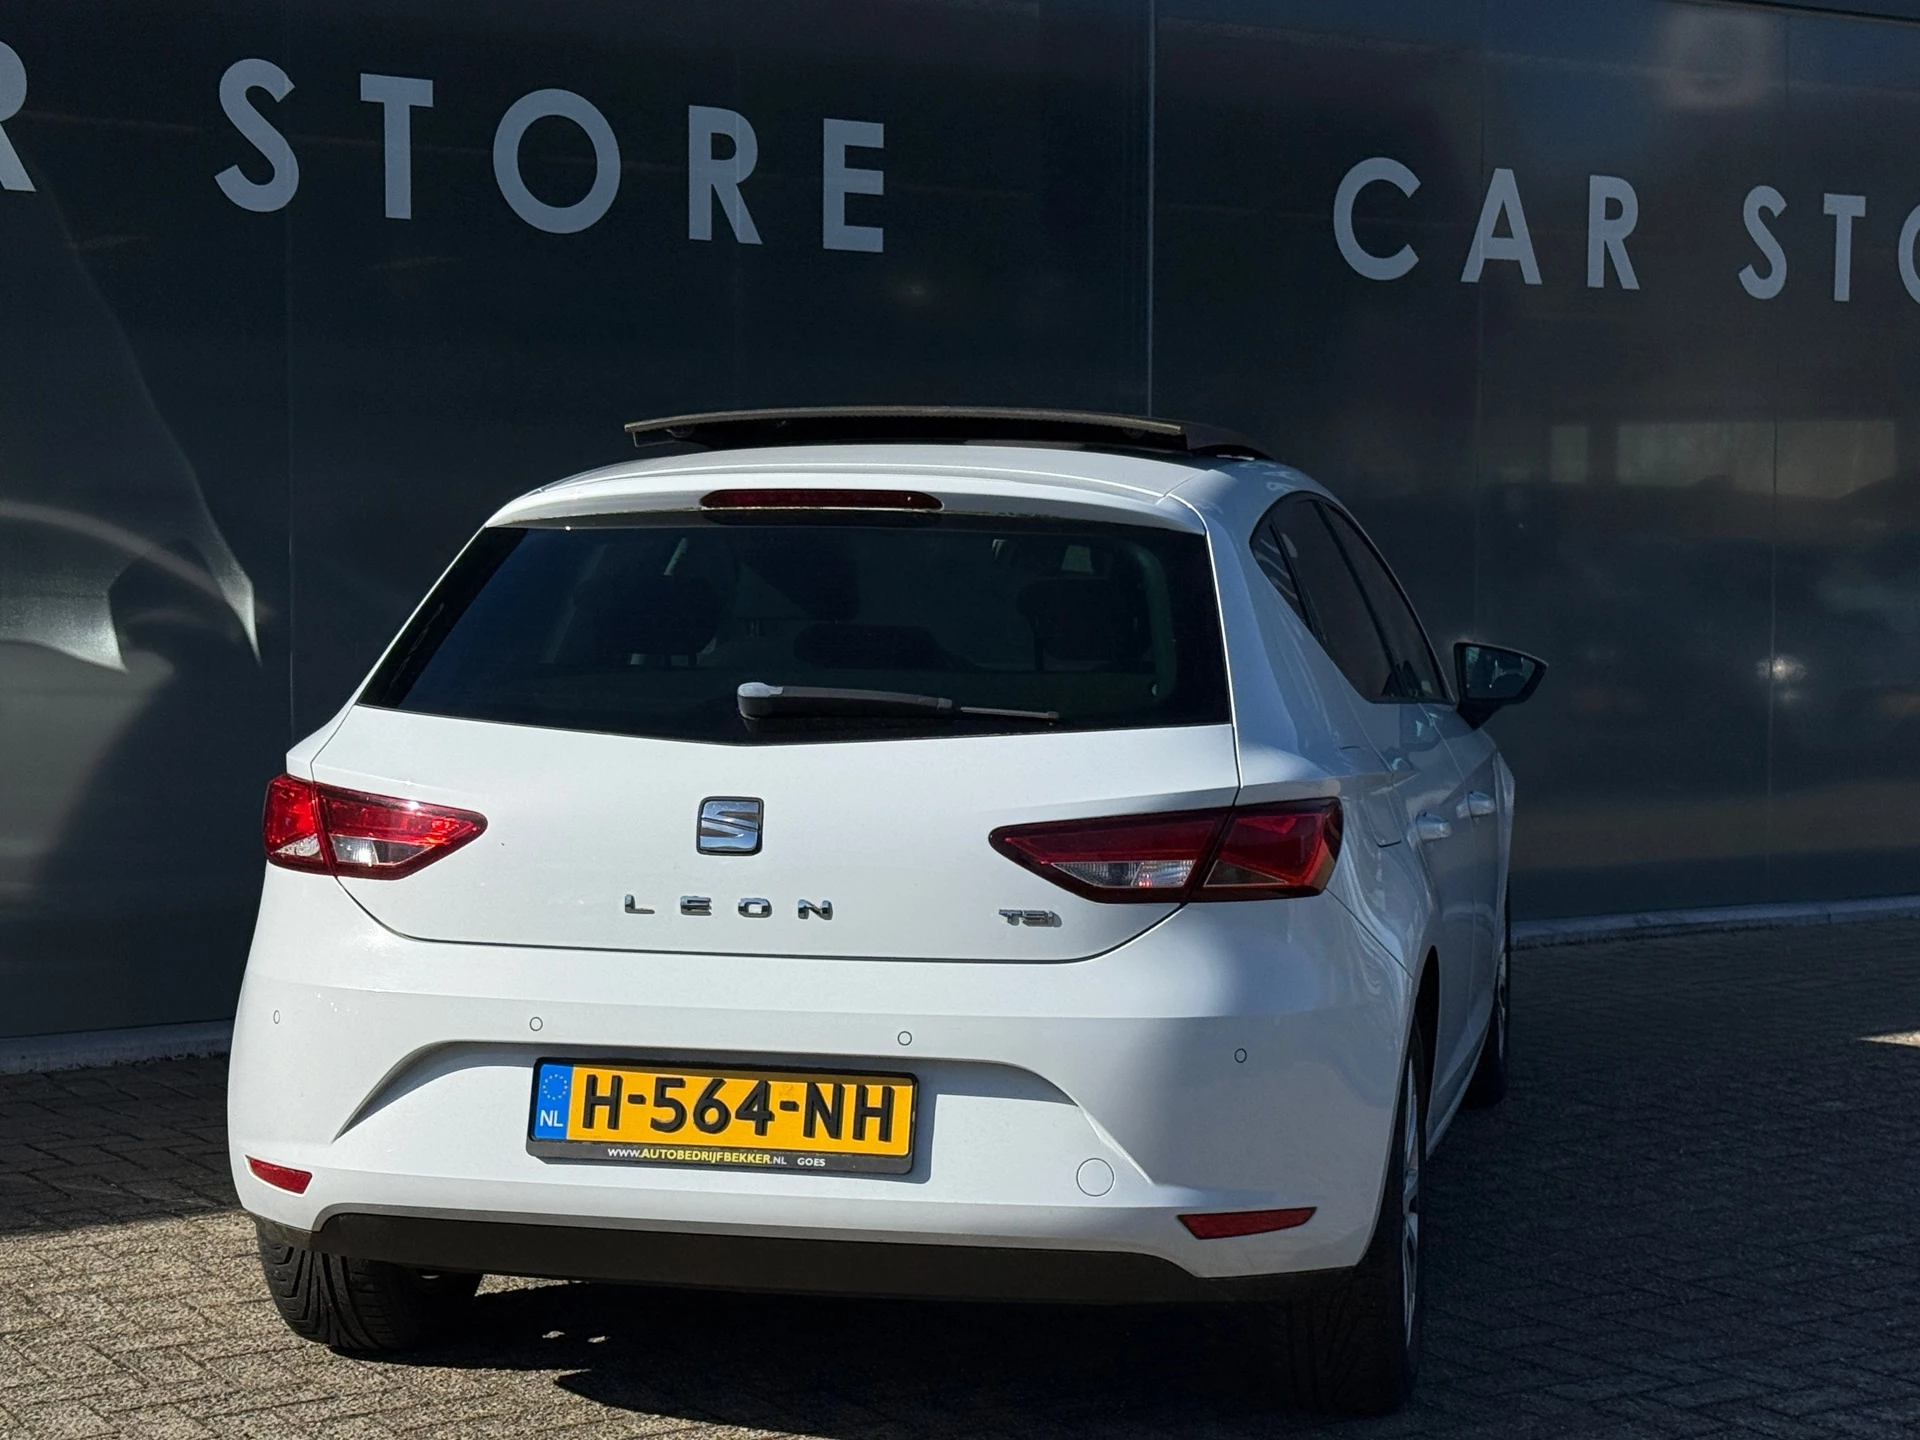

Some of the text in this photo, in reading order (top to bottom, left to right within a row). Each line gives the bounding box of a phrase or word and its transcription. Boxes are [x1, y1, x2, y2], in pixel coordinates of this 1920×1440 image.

[215, 58, 885, 253] STORE
[1333, 156, 1640, 290] CAR
[624, 894, 834, 921] LEON
[540, 1074, 896, 1142] NL H-564-NH
[797, 1157, 826, 1167] GOES
